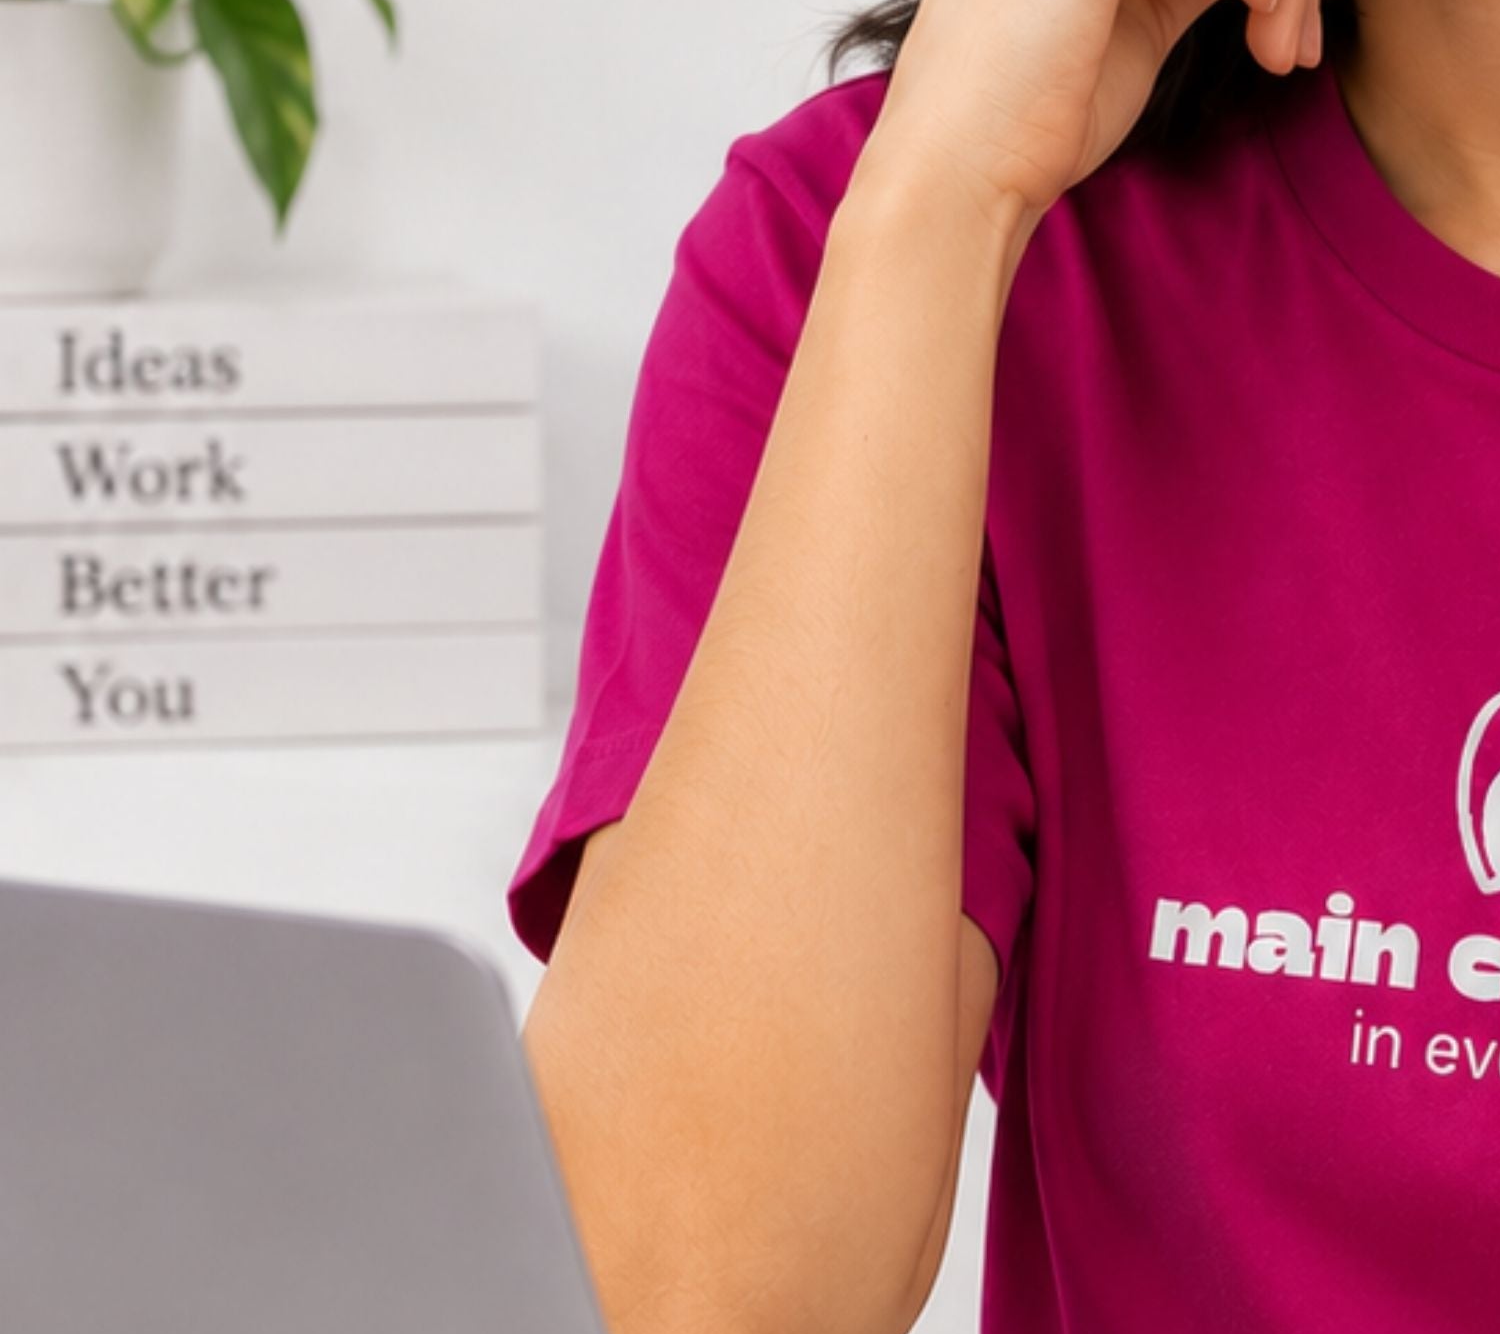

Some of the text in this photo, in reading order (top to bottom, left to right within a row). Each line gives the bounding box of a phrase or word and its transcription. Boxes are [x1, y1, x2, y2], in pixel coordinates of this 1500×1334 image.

[56, 326, 243, 398] Ideas
[54, 438, 246, 505] Work
[58, 551, 275, 618] Better
[58, 660, 197, 728] You
[1148, 890, 1421, 991] main
[1350, 1008, 1402, 1070] in
